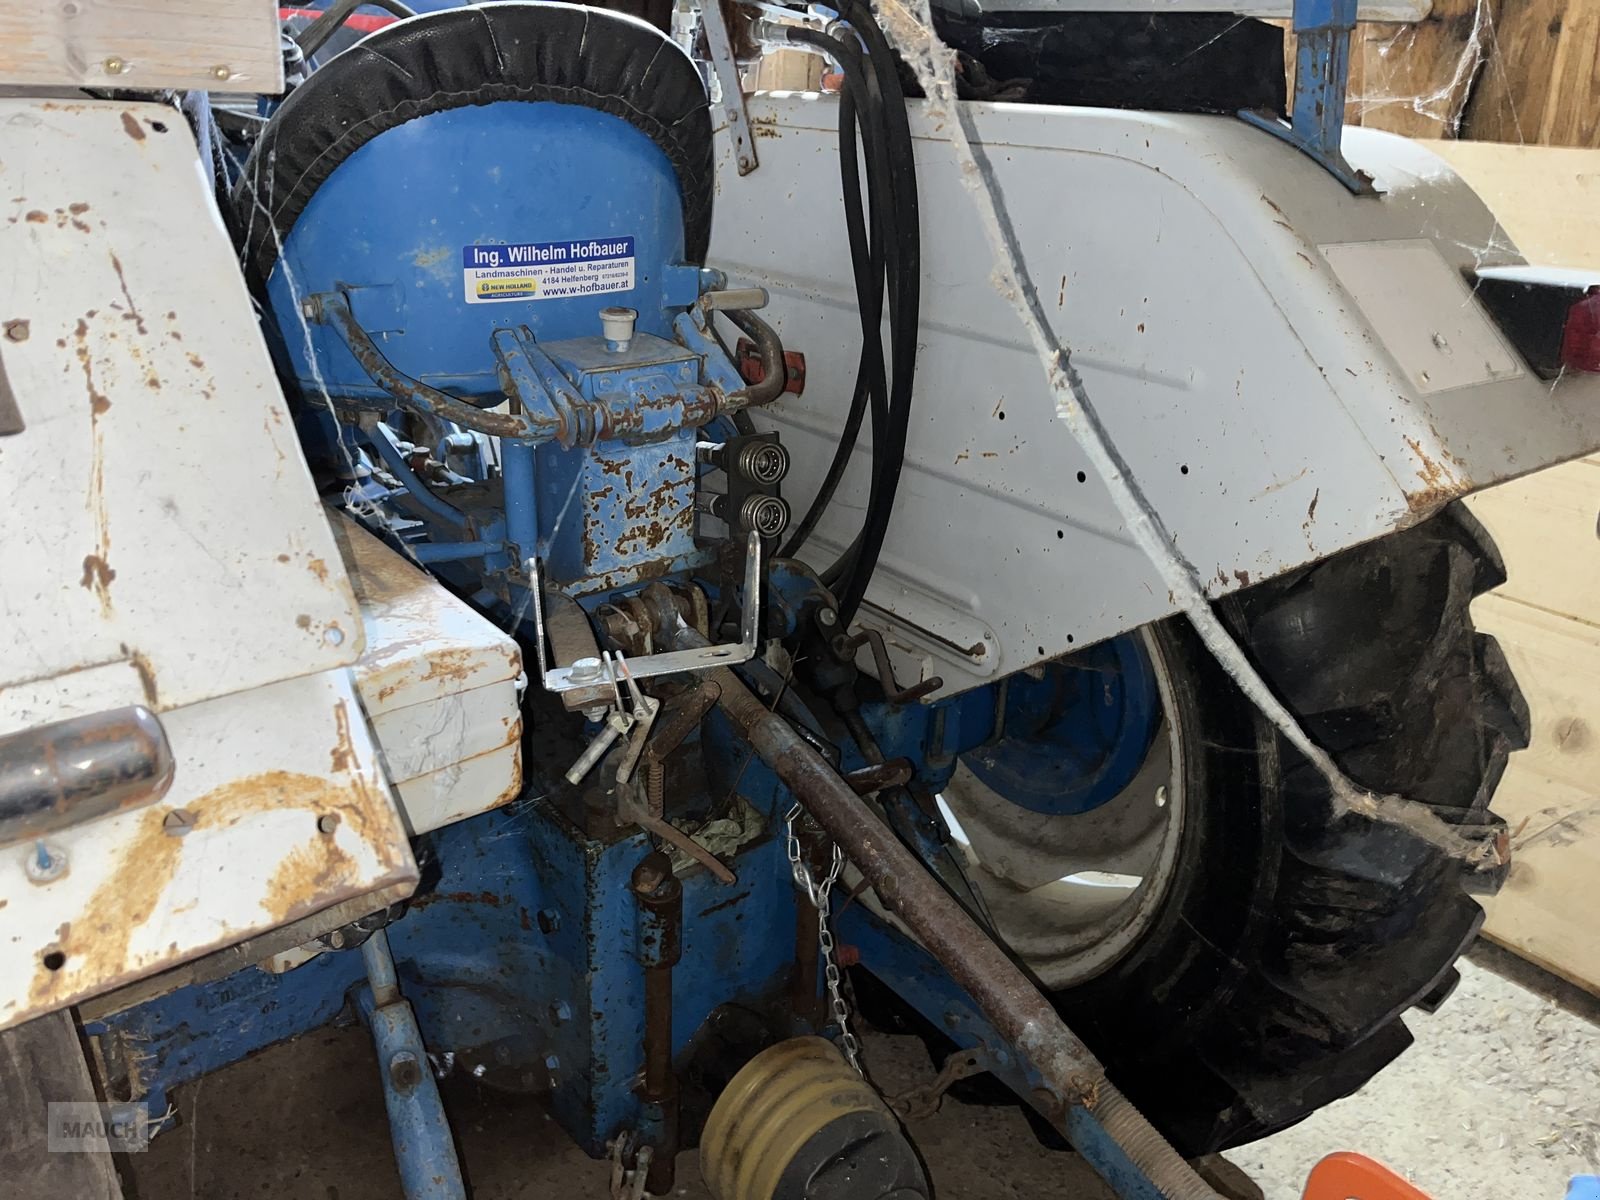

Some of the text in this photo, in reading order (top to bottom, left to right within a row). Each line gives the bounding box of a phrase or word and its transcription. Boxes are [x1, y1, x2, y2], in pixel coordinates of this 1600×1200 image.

[474, 241, 628, 267] Ing. Wilhelm Hofbauer
[475, 268, 543, 279] Landmaschinen
[550, 265, 577, 275] Handel
[587, 261, 629, 271] Reparaturen
[542, 277, 559, 285] 4184
[561, 274, 599, 284] Helfenberg
[543, 280, 629, 297] www.w-hofbauer.at
